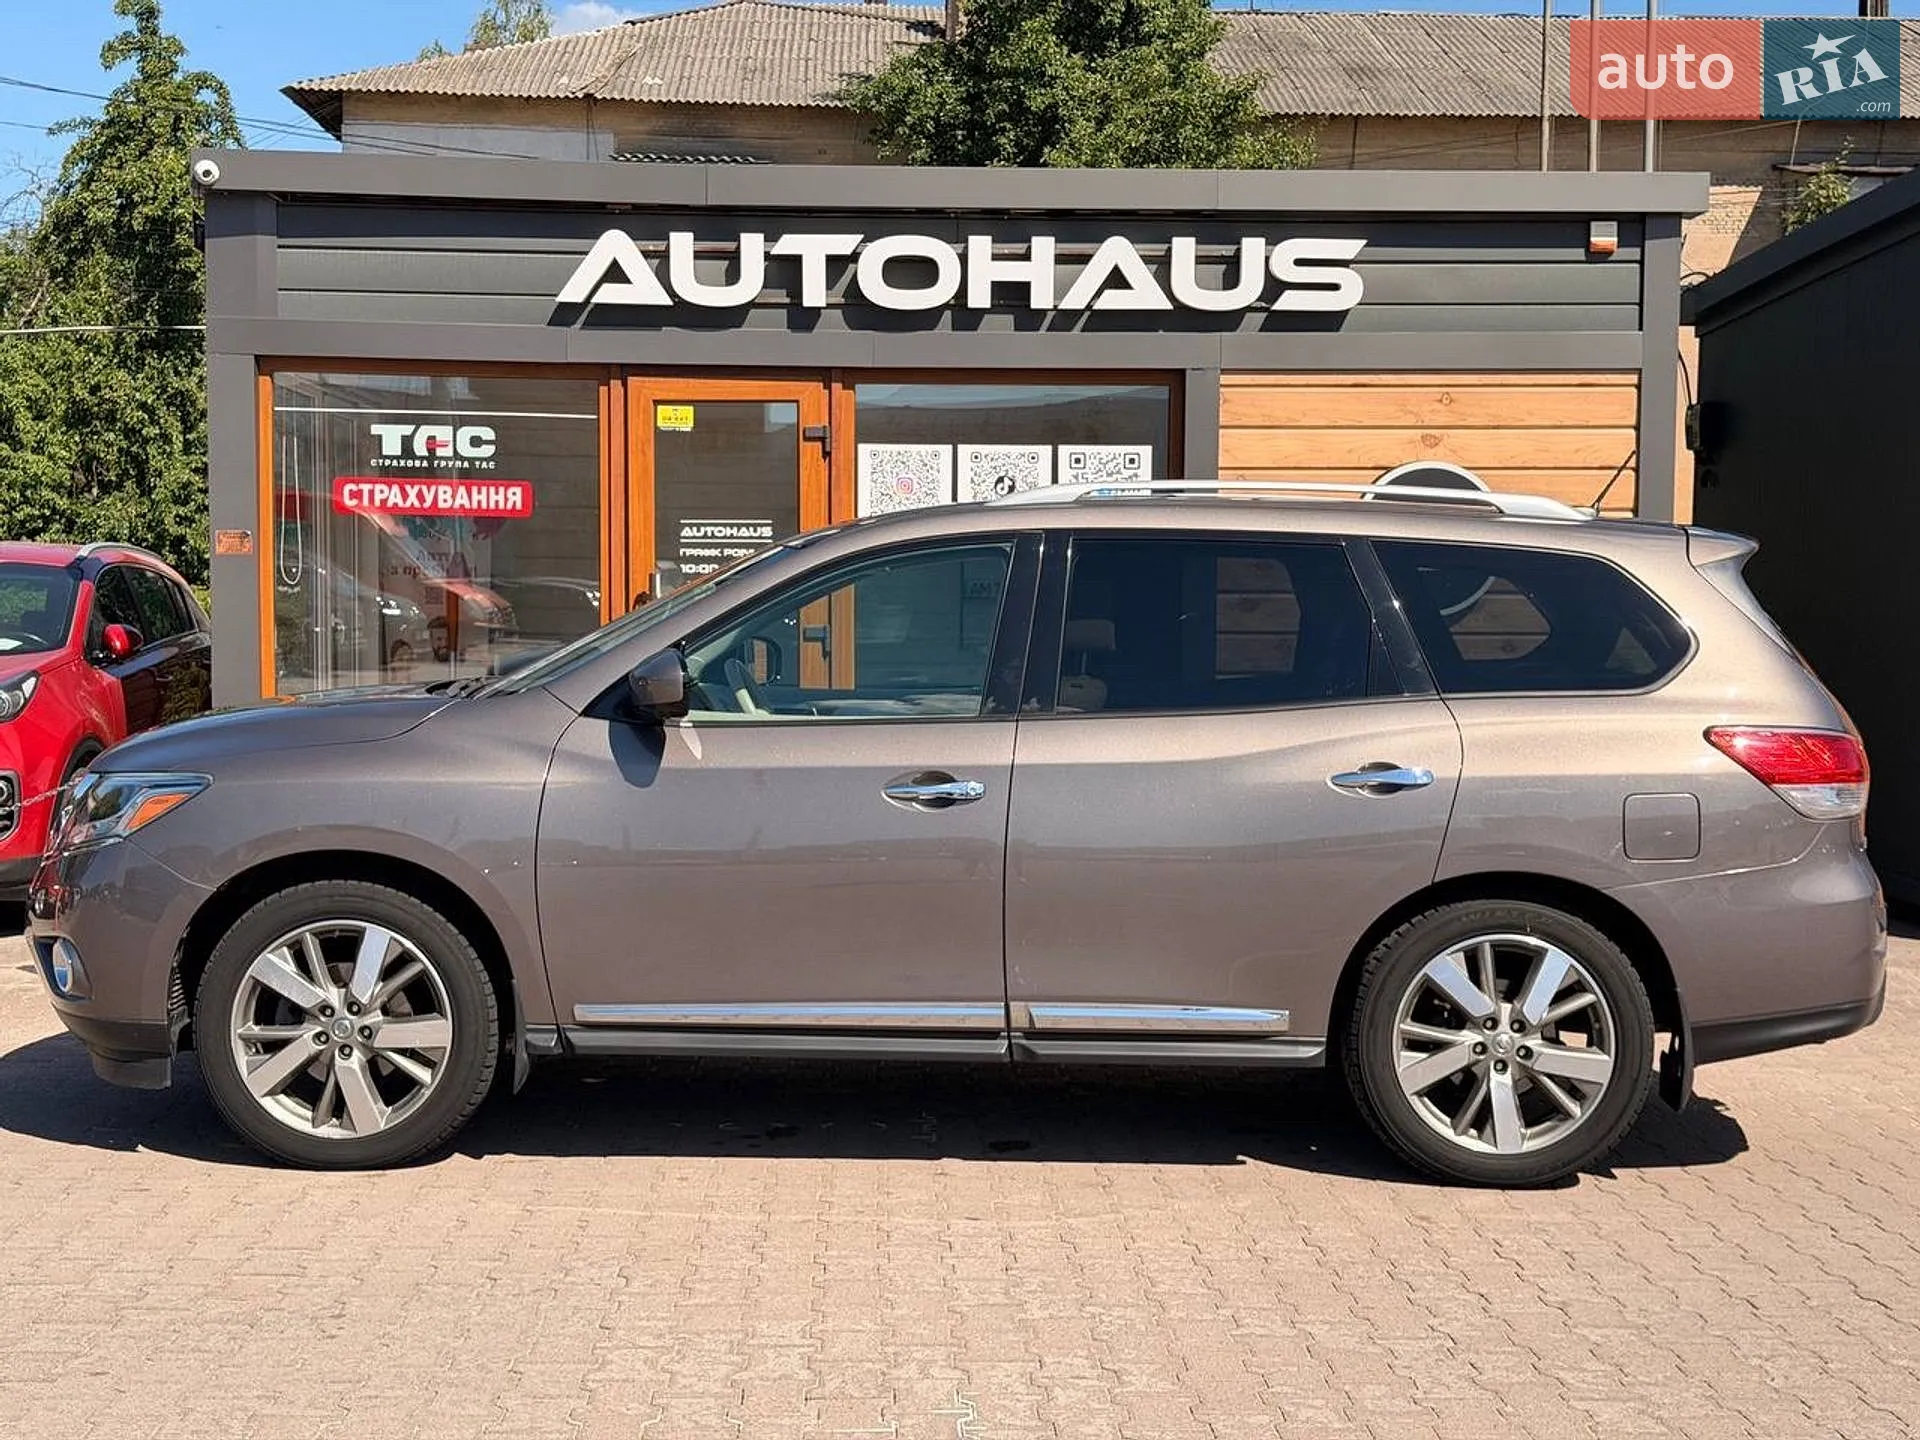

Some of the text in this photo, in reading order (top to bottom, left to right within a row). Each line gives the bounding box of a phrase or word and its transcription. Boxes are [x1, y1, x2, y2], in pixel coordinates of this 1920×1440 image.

[555, 229, 1367, 311] AUTOHAUS
[370, 424, 496, 458] ТАС
[370, 459, 429, 468] СТРАХОВА
[433, 460, 470, 469] ГРУПА
[342, 482, 523, 511] СТРАХУВАННЯ
[681, 526, 773, 538] AUTOHAUS
